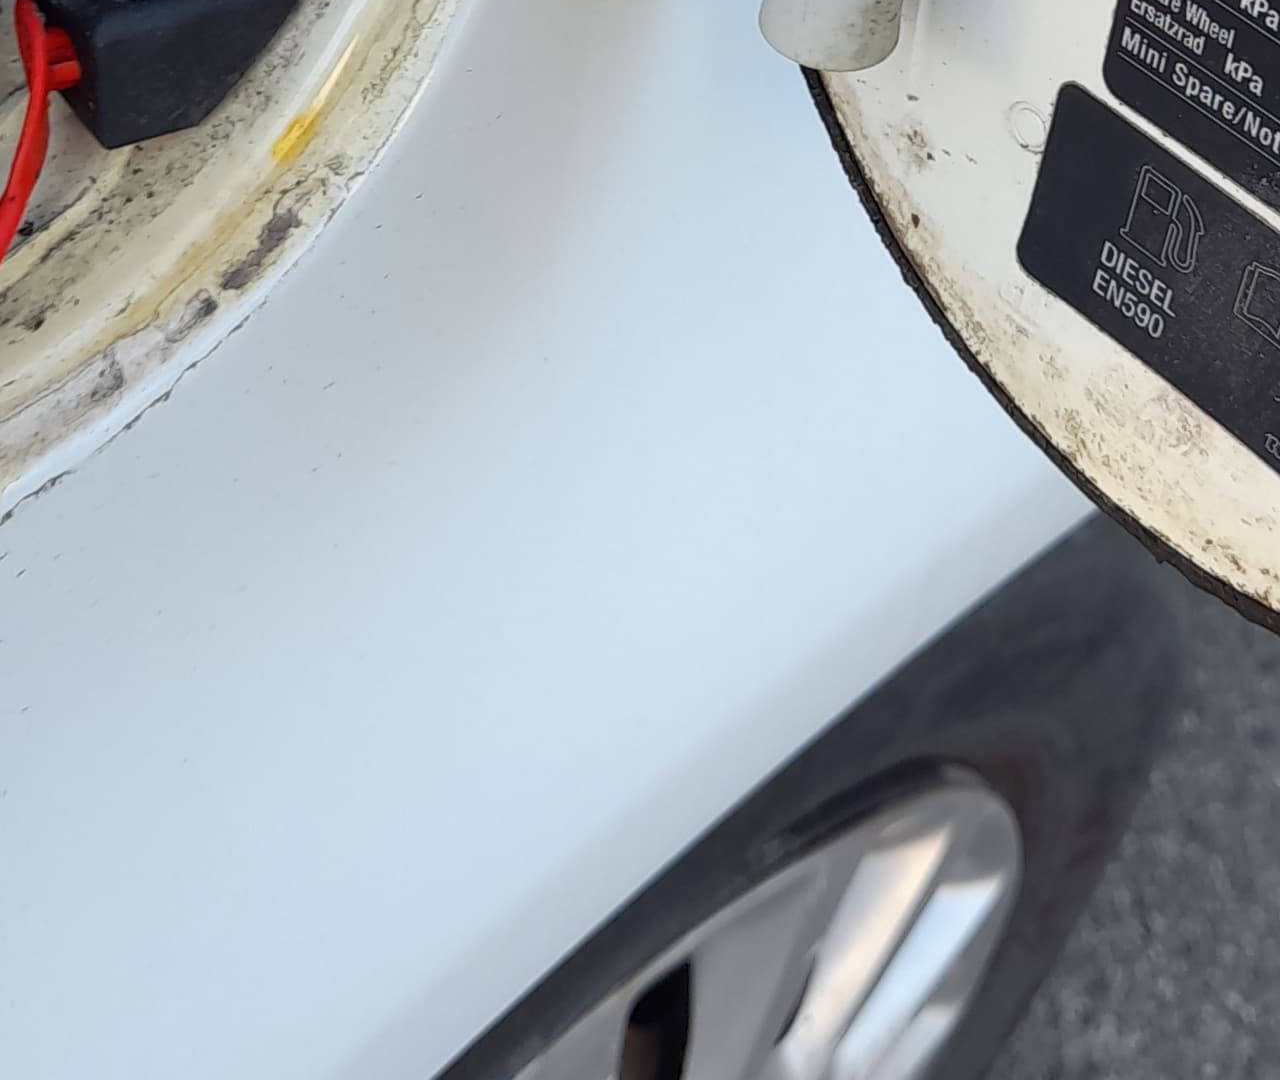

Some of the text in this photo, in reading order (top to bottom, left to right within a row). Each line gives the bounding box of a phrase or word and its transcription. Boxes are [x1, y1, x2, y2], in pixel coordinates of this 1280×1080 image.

[1185, 0, 1235, 49] Wheel
[1121, 26, 1166, 73] Mini
[1224, 52, 1263, 97] kPa
[1100, 241, 1175, 317] DIESEL
[1092, 270, 1164, 338] EN590
